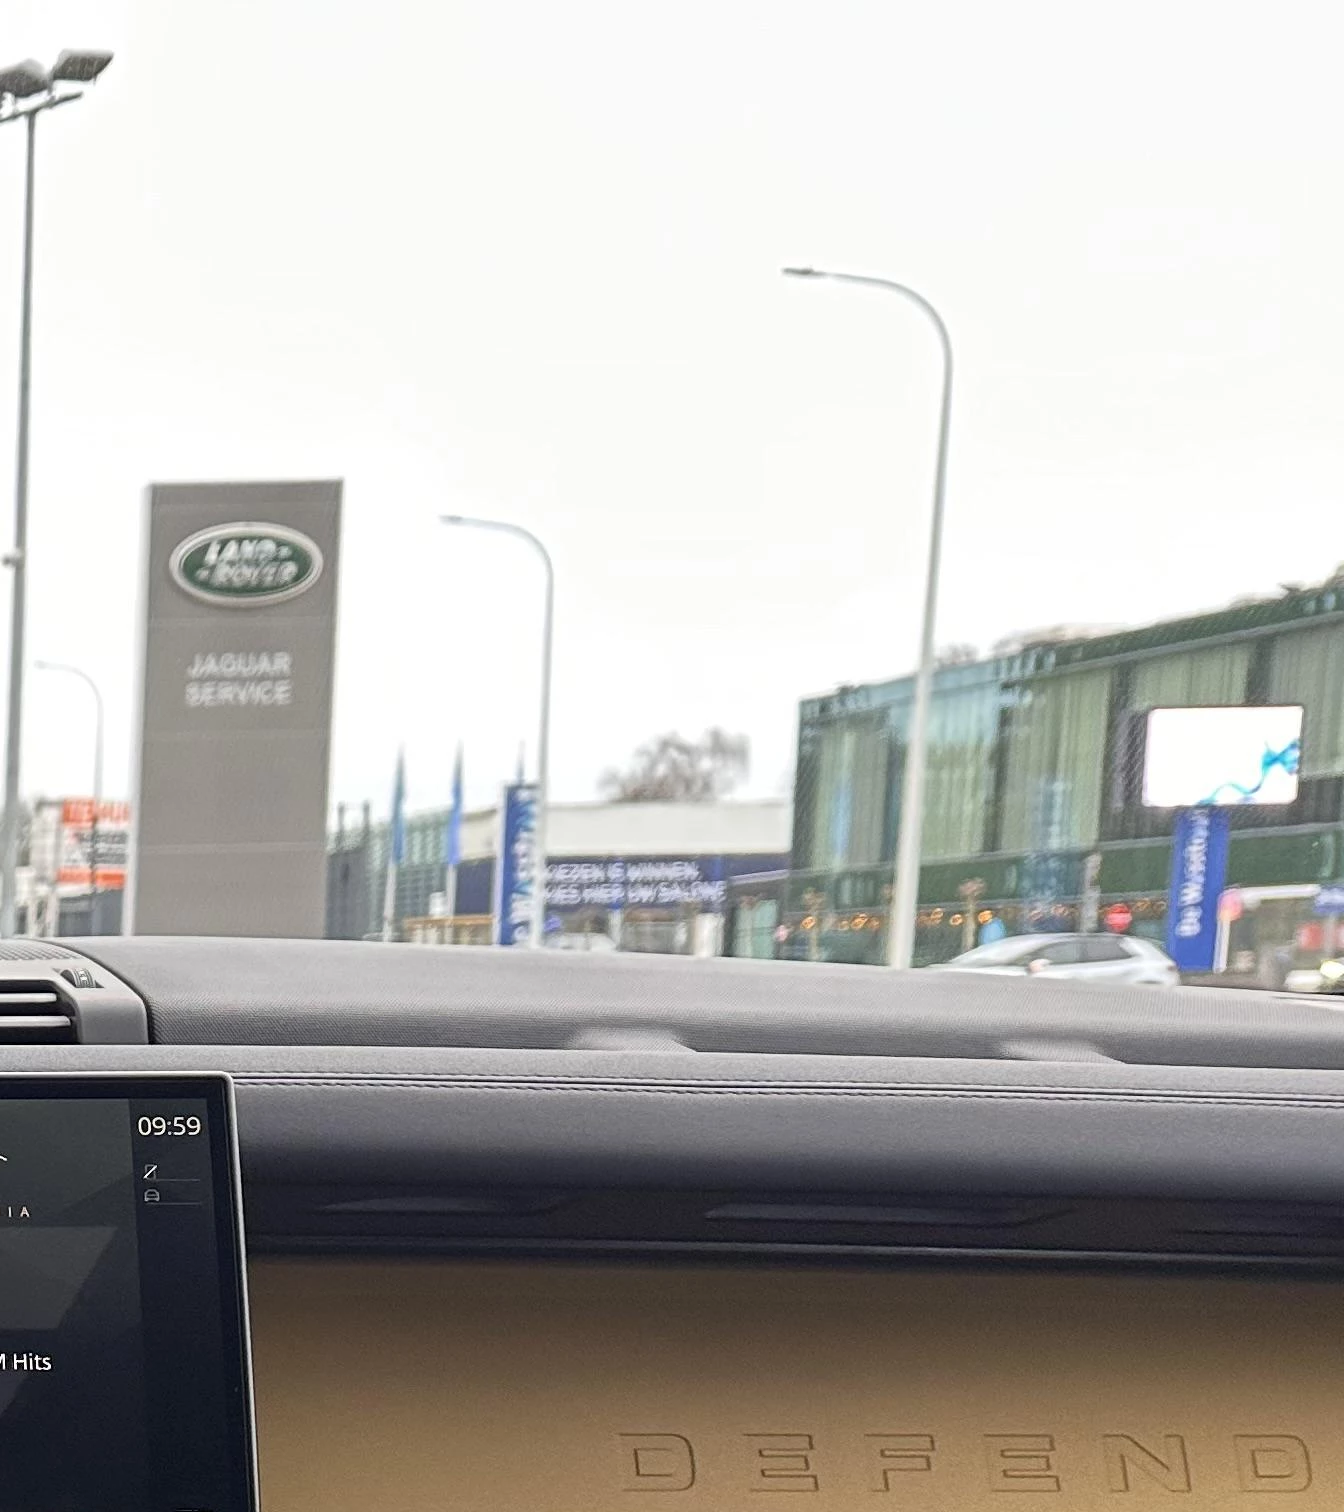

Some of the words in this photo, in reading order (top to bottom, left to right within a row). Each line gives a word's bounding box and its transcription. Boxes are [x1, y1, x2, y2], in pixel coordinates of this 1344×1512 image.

[204, 539, 277, 565] LAND
[188, 651, 292, 678] JAGUAR
[185, 679, 292, 707] SERVICE
[137, 1115, 202, 1136] 09:59
[13, 1353, 53, 1371] Hits
[616, 1432, 1313, 1493] DEFEND
